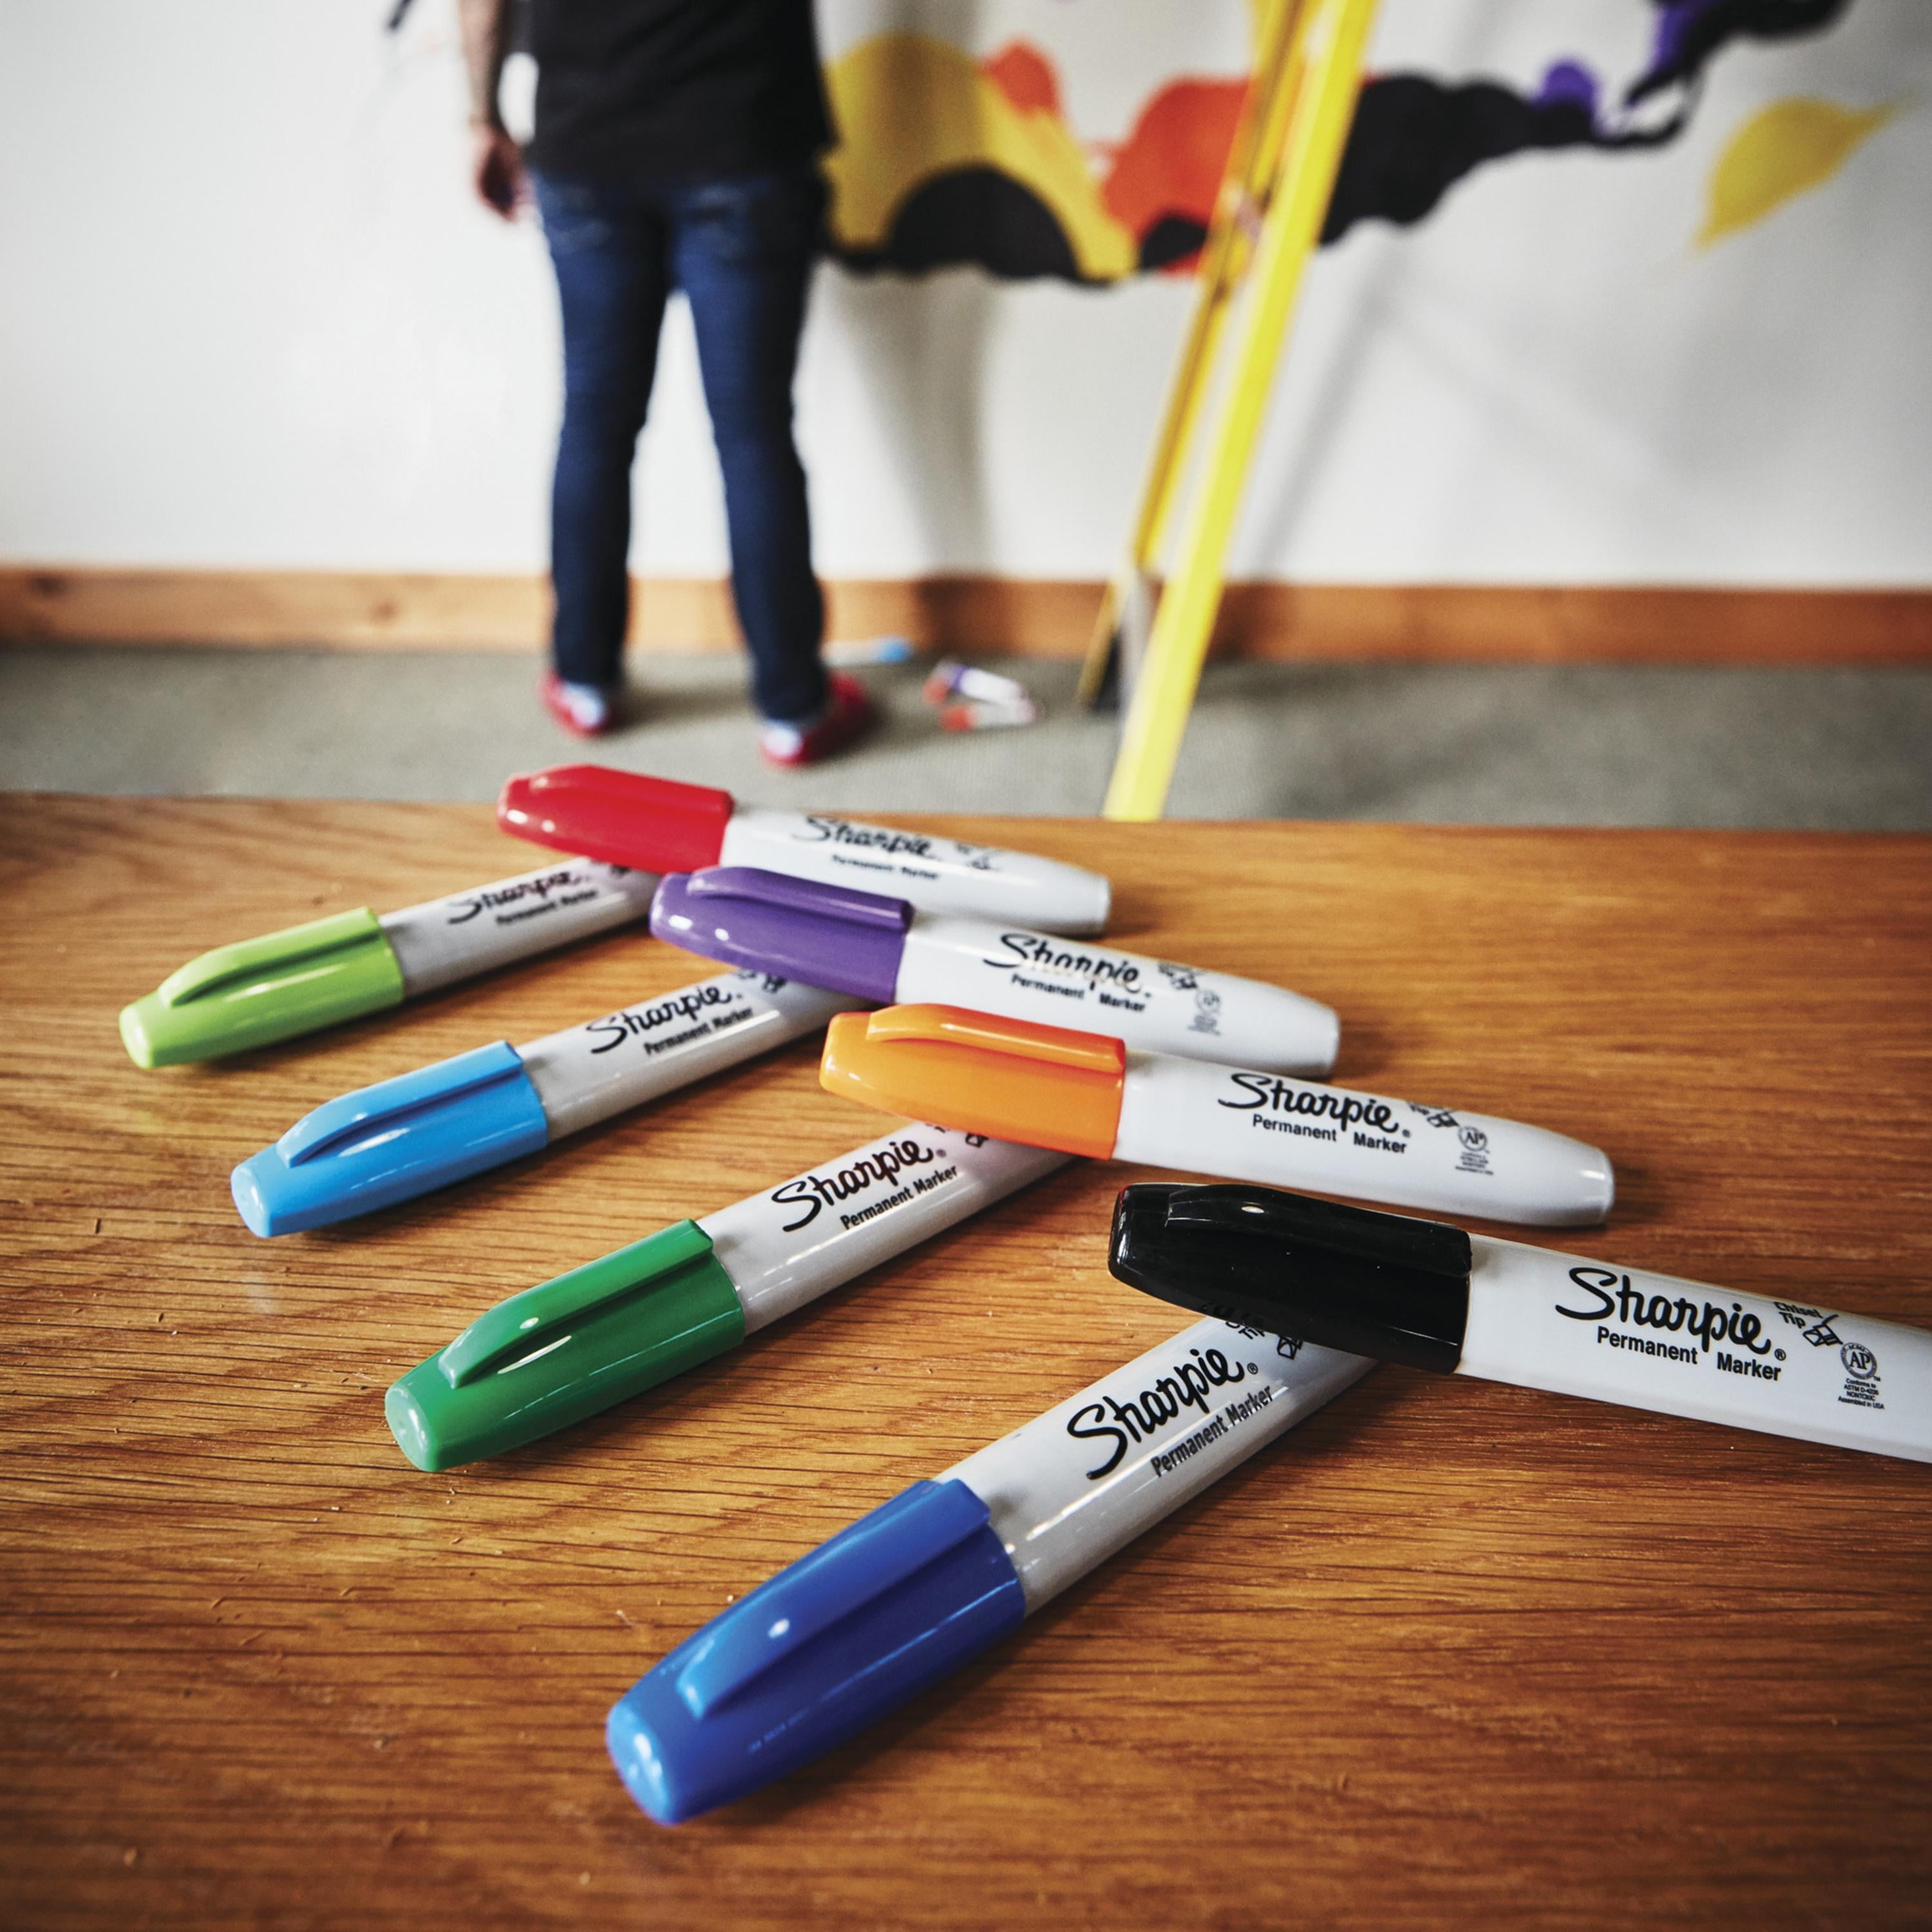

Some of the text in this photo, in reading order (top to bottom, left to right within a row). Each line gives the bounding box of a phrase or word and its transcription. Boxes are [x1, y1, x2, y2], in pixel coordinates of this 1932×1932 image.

[983, 933, 1141, 994] Sharpie
[585, 985, 732, 1054] Sharpie
[1011, 974, 1146, 1012] Permanent Marker
[643, 1007, 753, 1055] Permanent Marker
[1218, 1072, 1399, 1134] Sharpie
[1253, 1114, 1407, 1153] Permanent Marker
[772, 1140, 934, 1232] Sharpie
[840, 1165, 958, 1231] Permanent Marker
[1555, 1267, 1772, 1354] Sharpie
[1774, 1302, 1823, 1319] Chisel
[1779, 1311, 1806, 1329] Tip
[1597, 1325, 1782, 1381] Permanent Marker
[1850, 1351, 1870, 1369] AP
[1066, 1349, 1245, 1481] Sharpie
[1838, 1396, 1865, 1406] Assembled
[1150, 1385, 1274, 1478] Permanent Marker
